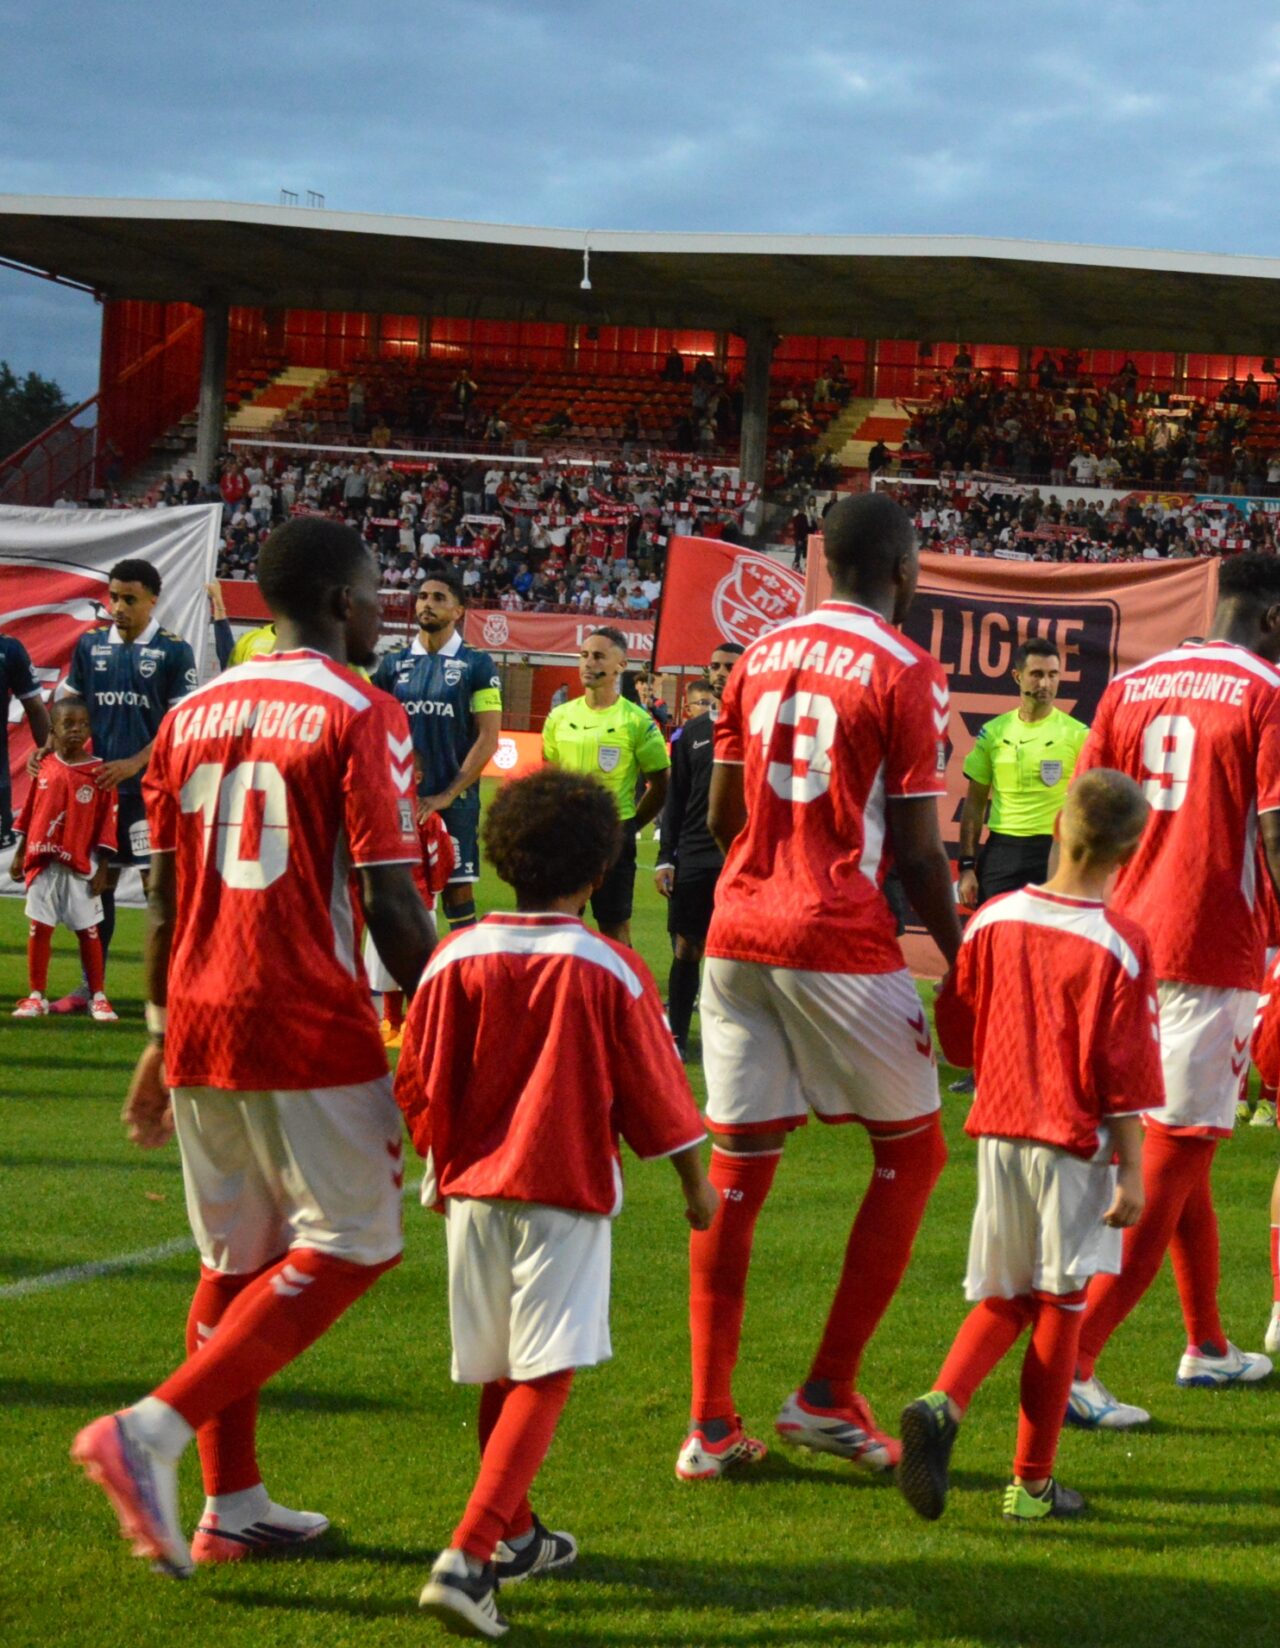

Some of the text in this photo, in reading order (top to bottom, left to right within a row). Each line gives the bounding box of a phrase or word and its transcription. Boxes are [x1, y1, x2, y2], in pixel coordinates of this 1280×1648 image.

[747, 638, 876, 687] CAMARA
[95, 691, 151, 709] TOYOTA
[402, 700, 455, 718] OYOTA
[1123, 671, 1250, 706] TCHOKOUNTE
[172, 699, 327, 749] KARAMOKO
[749, 690, 839, 804] 13
[1142, 715, 1196, 812] 9
[180, 760, 290, 890] 10
[723, 1188, 744, 1202] 13
